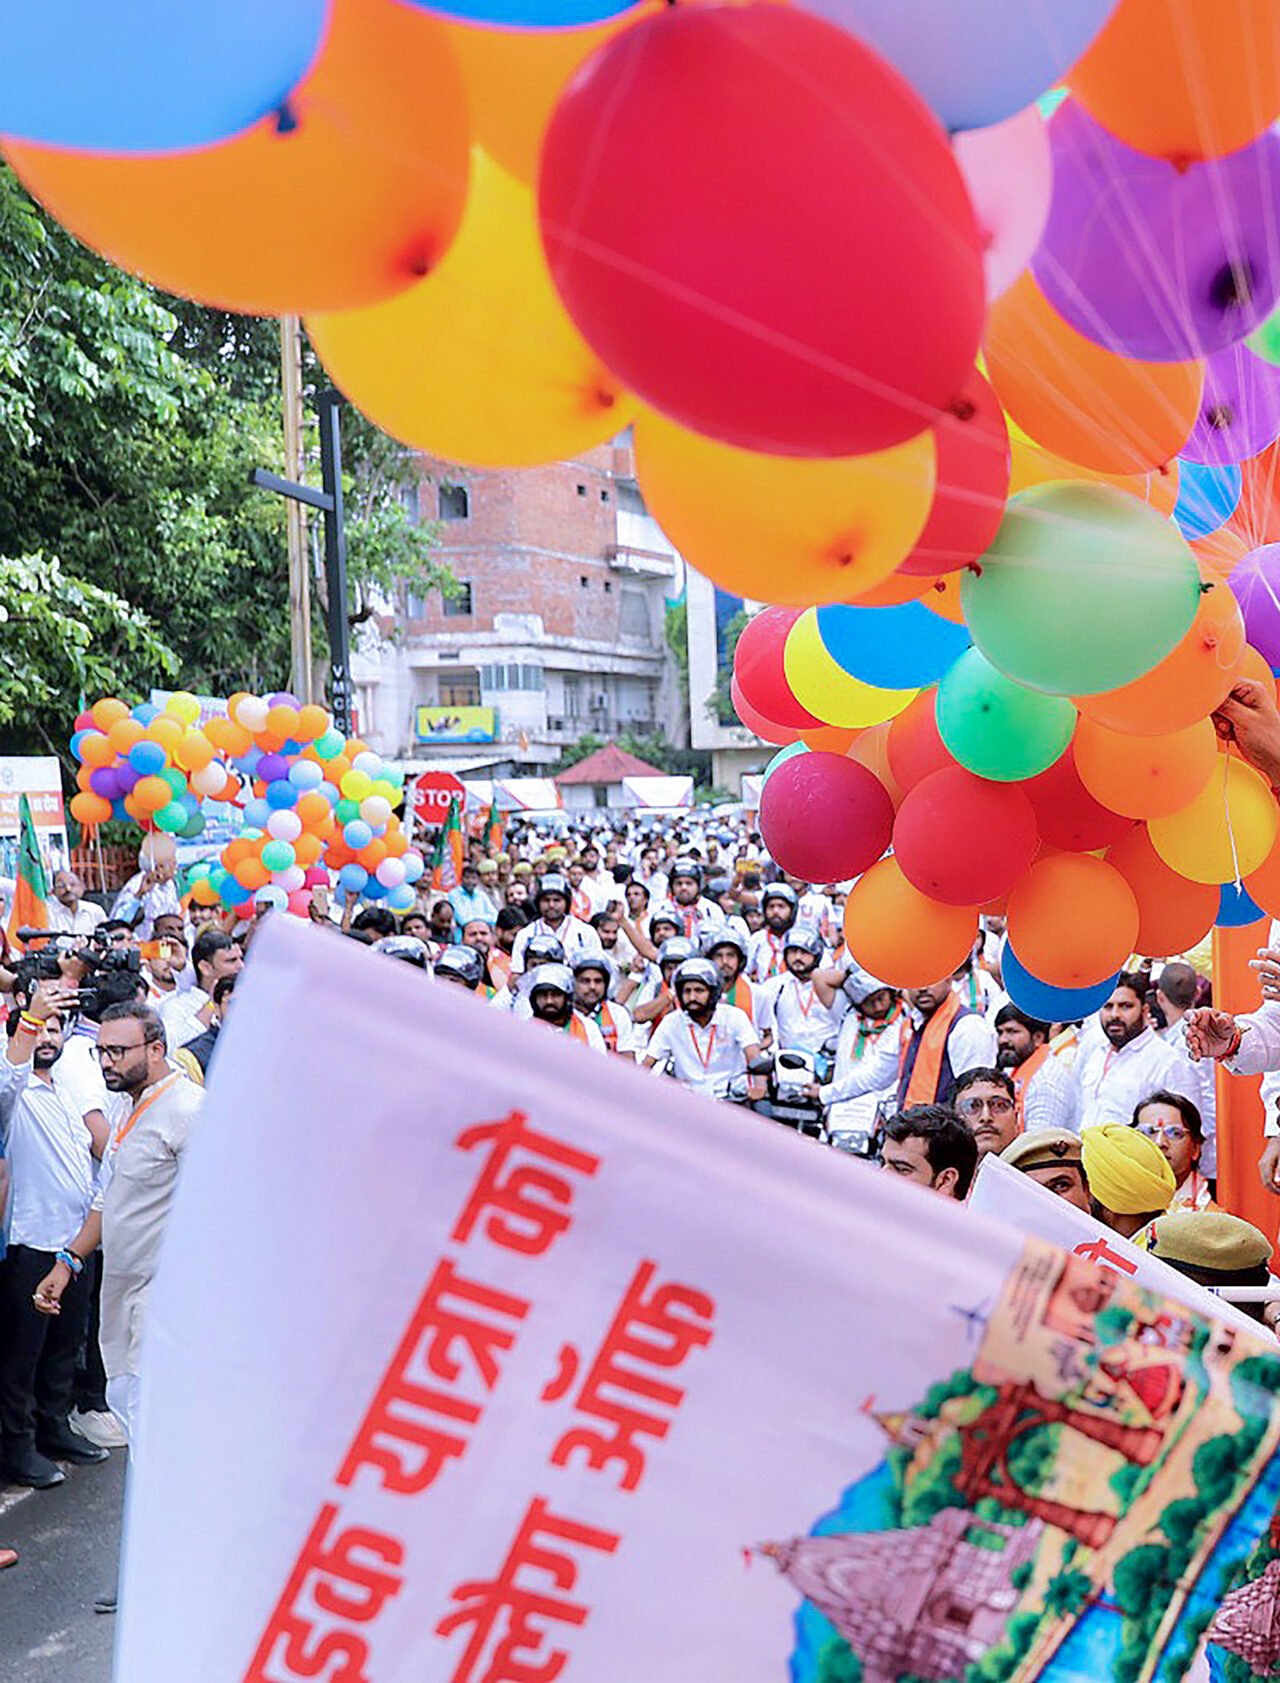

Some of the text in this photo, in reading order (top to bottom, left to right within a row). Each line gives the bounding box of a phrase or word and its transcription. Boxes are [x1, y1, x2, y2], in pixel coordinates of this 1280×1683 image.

[413, 790, 463, 807] STOP
[243, 1111, 601, 1683] इक यात्रा को
[435, 1261, 715, 1683] लैग ऑफ
